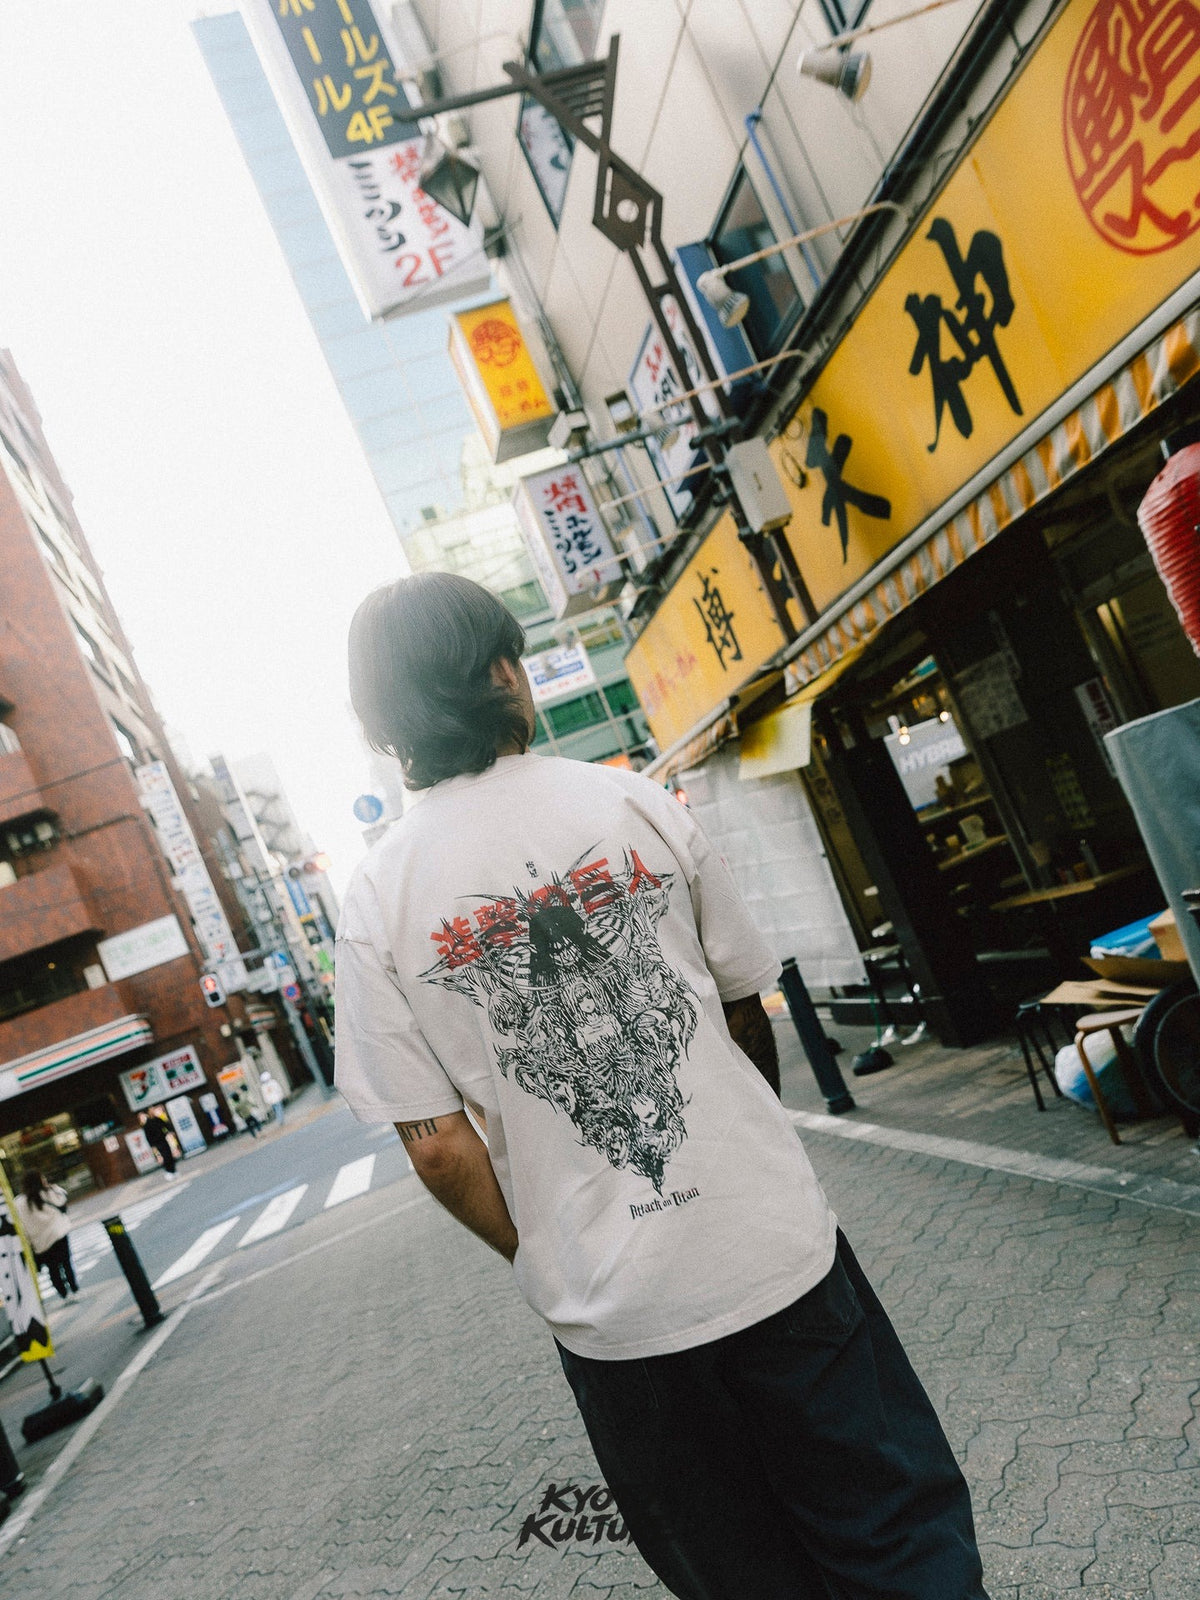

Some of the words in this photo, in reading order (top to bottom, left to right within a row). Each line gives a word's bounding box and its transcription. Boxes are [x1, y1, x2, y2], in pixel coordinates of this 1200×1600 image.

[346, 104, 394, 144] 4F
[395, 241, 454, 288] 2F
[629, 1198, 663, 1220] Attack
[662, 1199, 673, 1208] on
[669, 1187, 700, 1207] Titan
